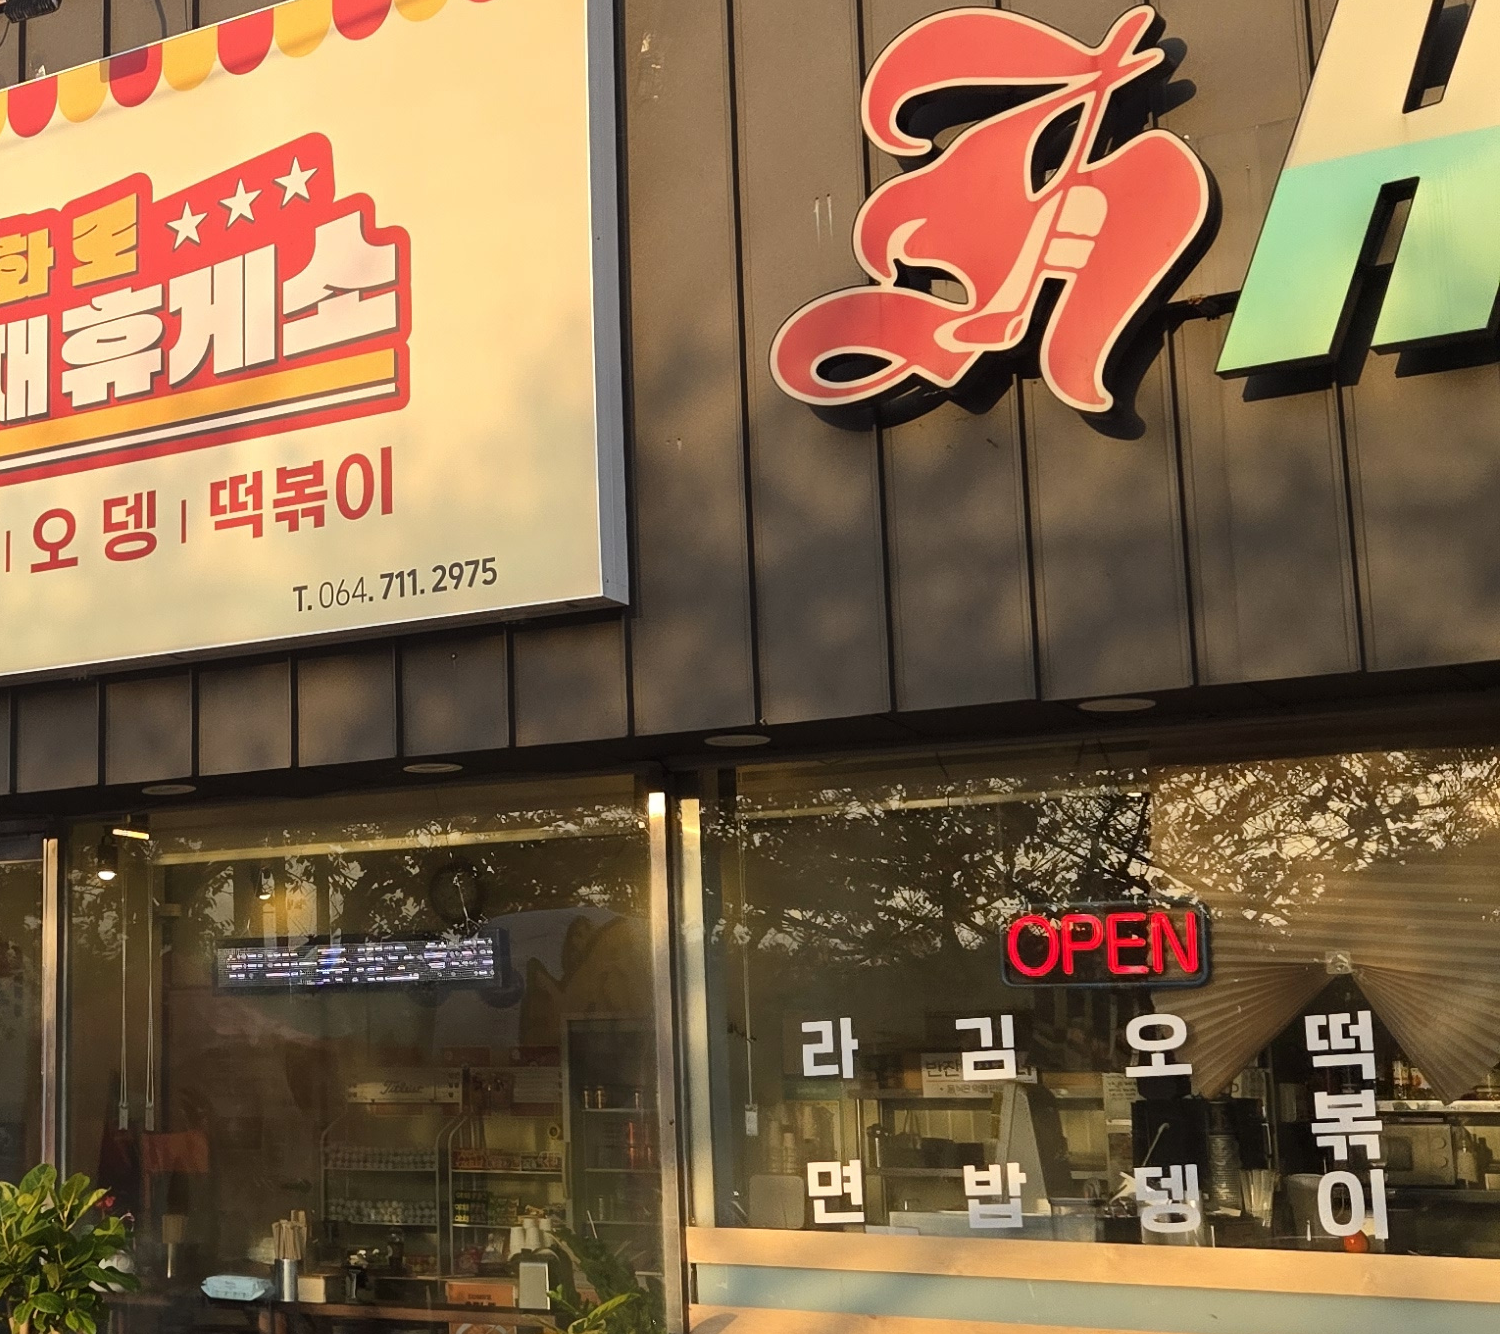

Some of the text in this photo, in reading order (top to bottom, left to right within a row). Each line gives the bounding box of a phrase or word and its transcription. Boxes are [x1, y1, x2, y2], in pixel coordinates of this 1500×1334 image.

[30, 489, 158, 574] 오뎅
[209, 446, 394, 539] 떡볶이
[1006, 912, 1200, 978] OPEN
[801, 1016, 865, 1224] 라면
[955, 1014, 1027, 1229] 김밥
[1125, 1013, 1200, 1233] 오뎅
[1304, 1010, 1388, 1240] 떡볶이
